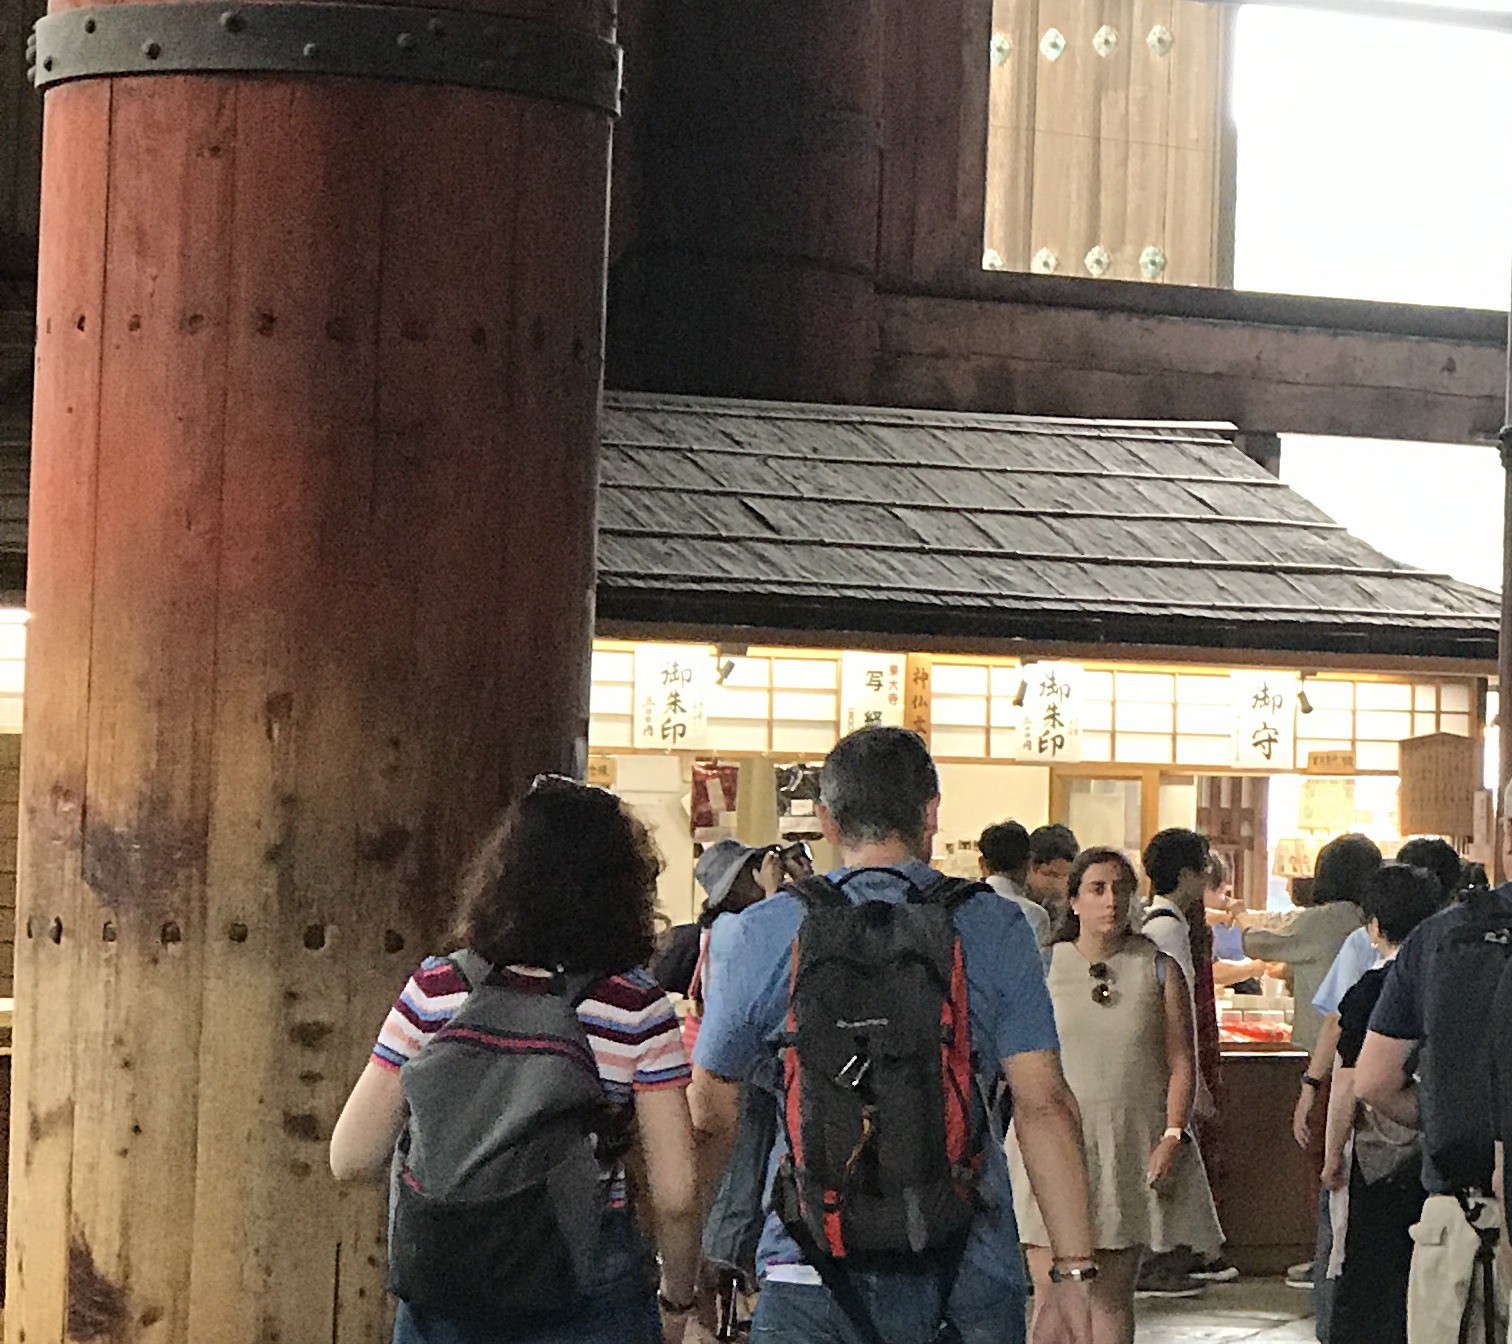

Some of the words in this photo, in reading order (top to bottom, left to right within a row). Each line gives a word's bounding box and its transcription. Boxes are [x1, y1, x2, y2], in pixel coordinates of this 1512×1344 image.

[660, 660, 693, 744] 御朱印
[1039, 669, 1071, 757] 御朱印
[1251, 681, 1284, 761] 御守
